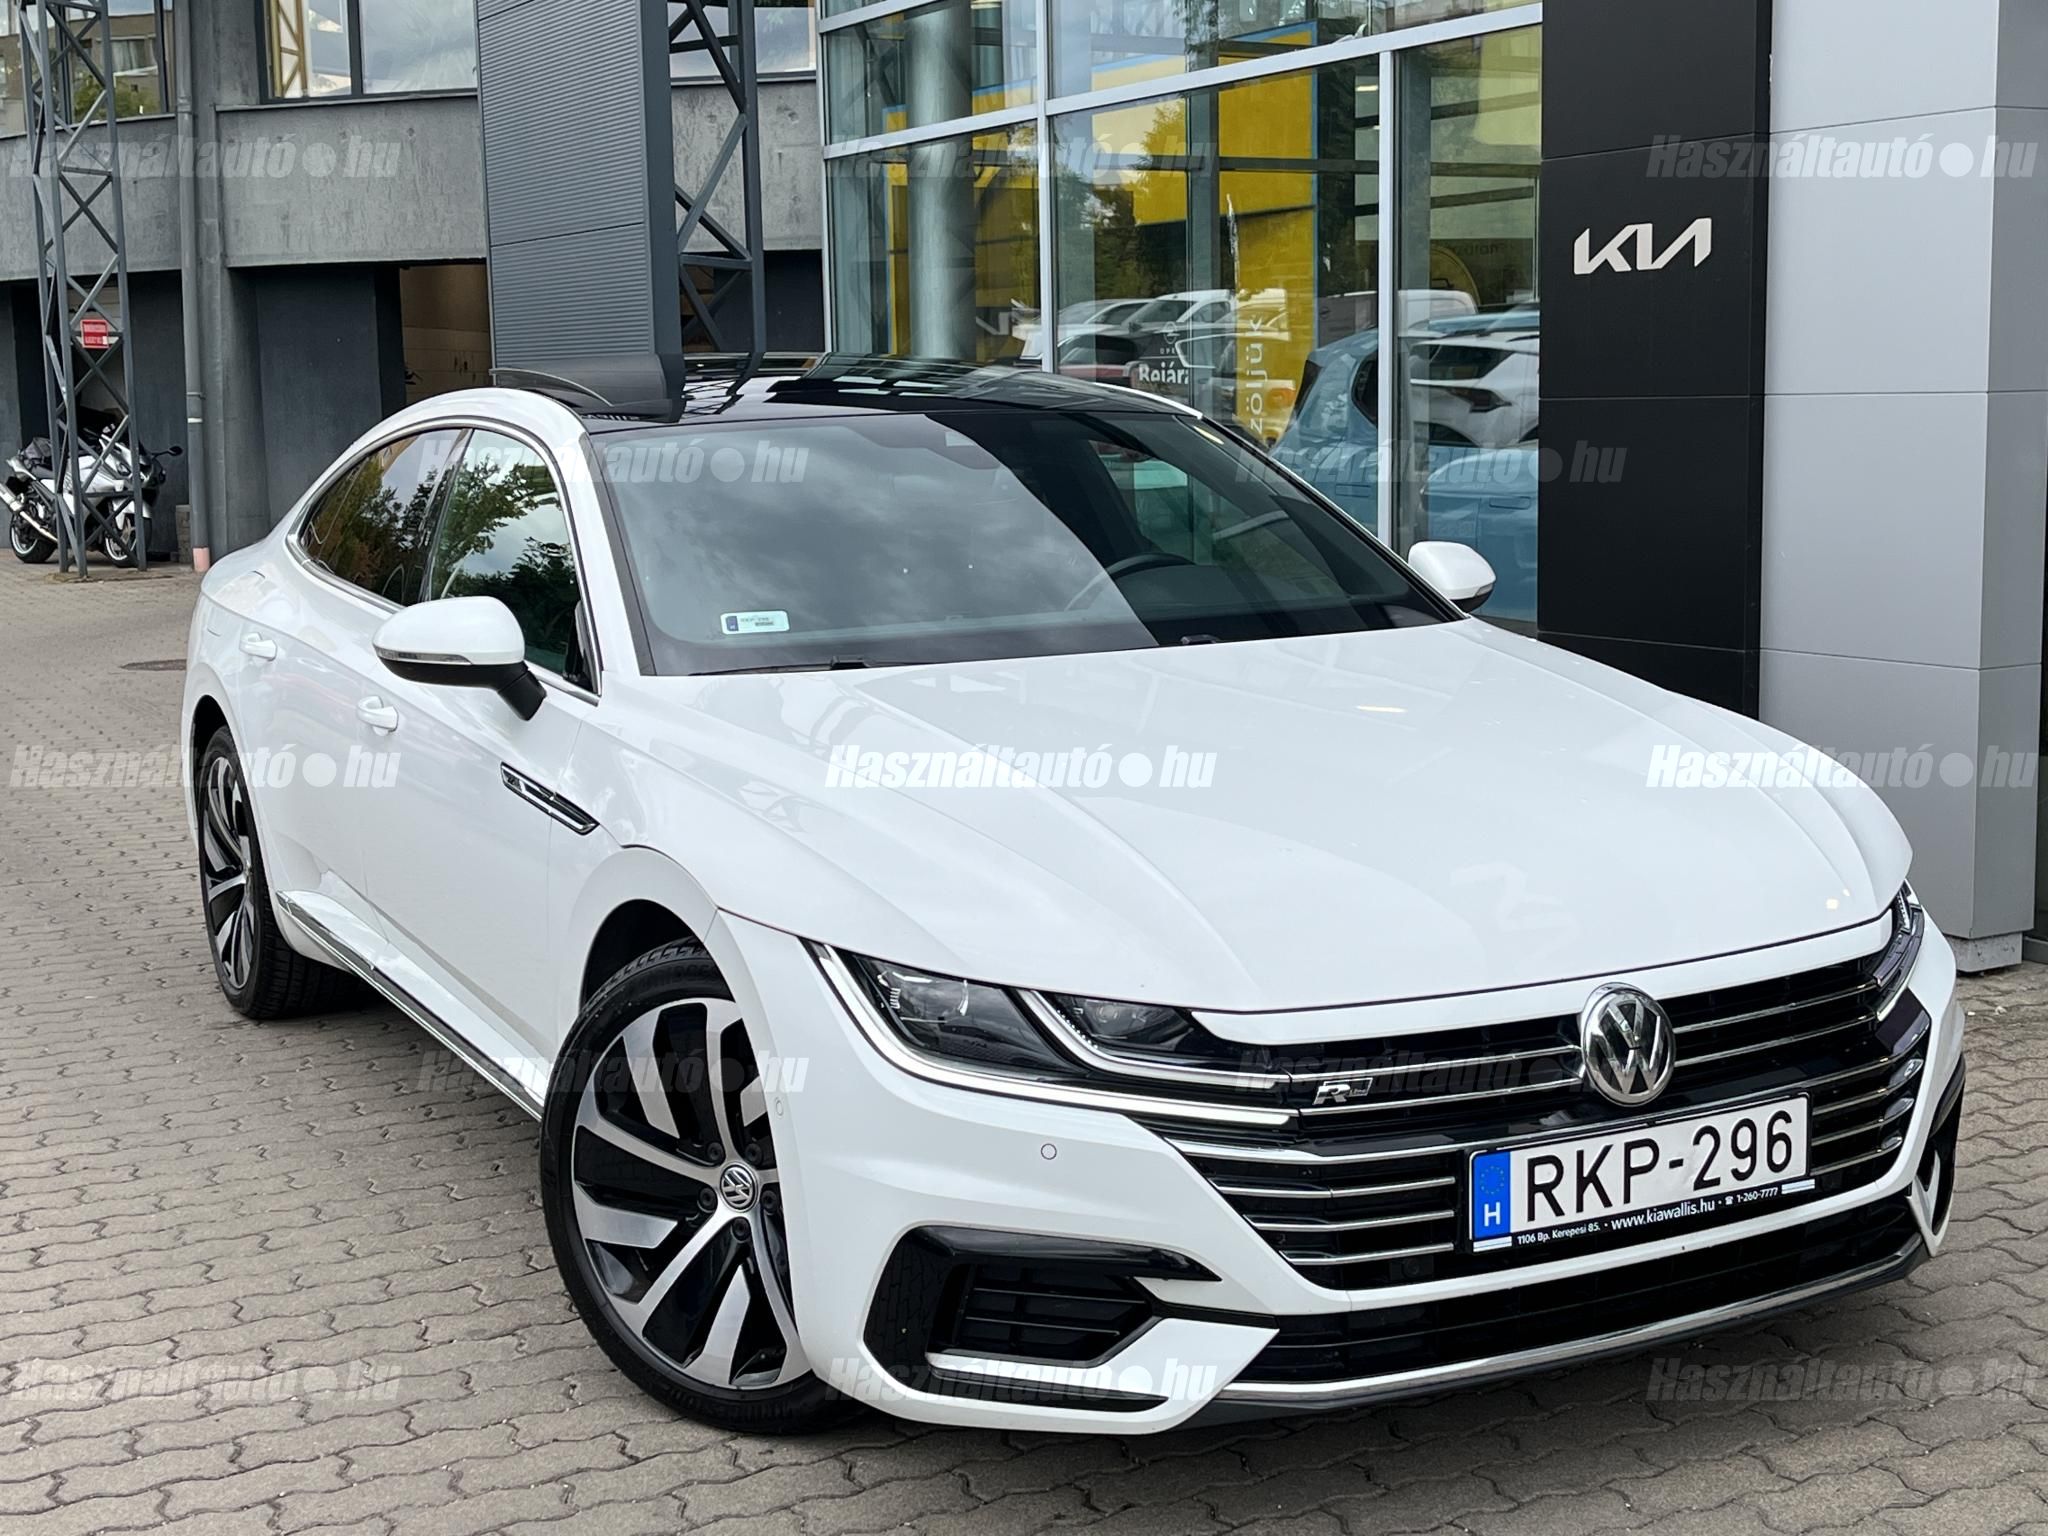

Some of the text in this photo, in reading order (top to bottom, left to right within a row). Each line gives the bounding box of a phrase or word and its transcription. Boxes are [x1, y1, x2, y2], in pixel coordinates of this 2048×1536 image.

[1573, 217, 1712, 275] KIA
[1527, 1110, 1793, 1222] RKP-296
[1484, 1202, 1501, 1227] H
[1517, 1233, 1536, 1245] 1106
[1552, 1225, 1587, 1239] Kerepesi
[1611, 1199, 1716, 1230] www.kiawallis.hu
